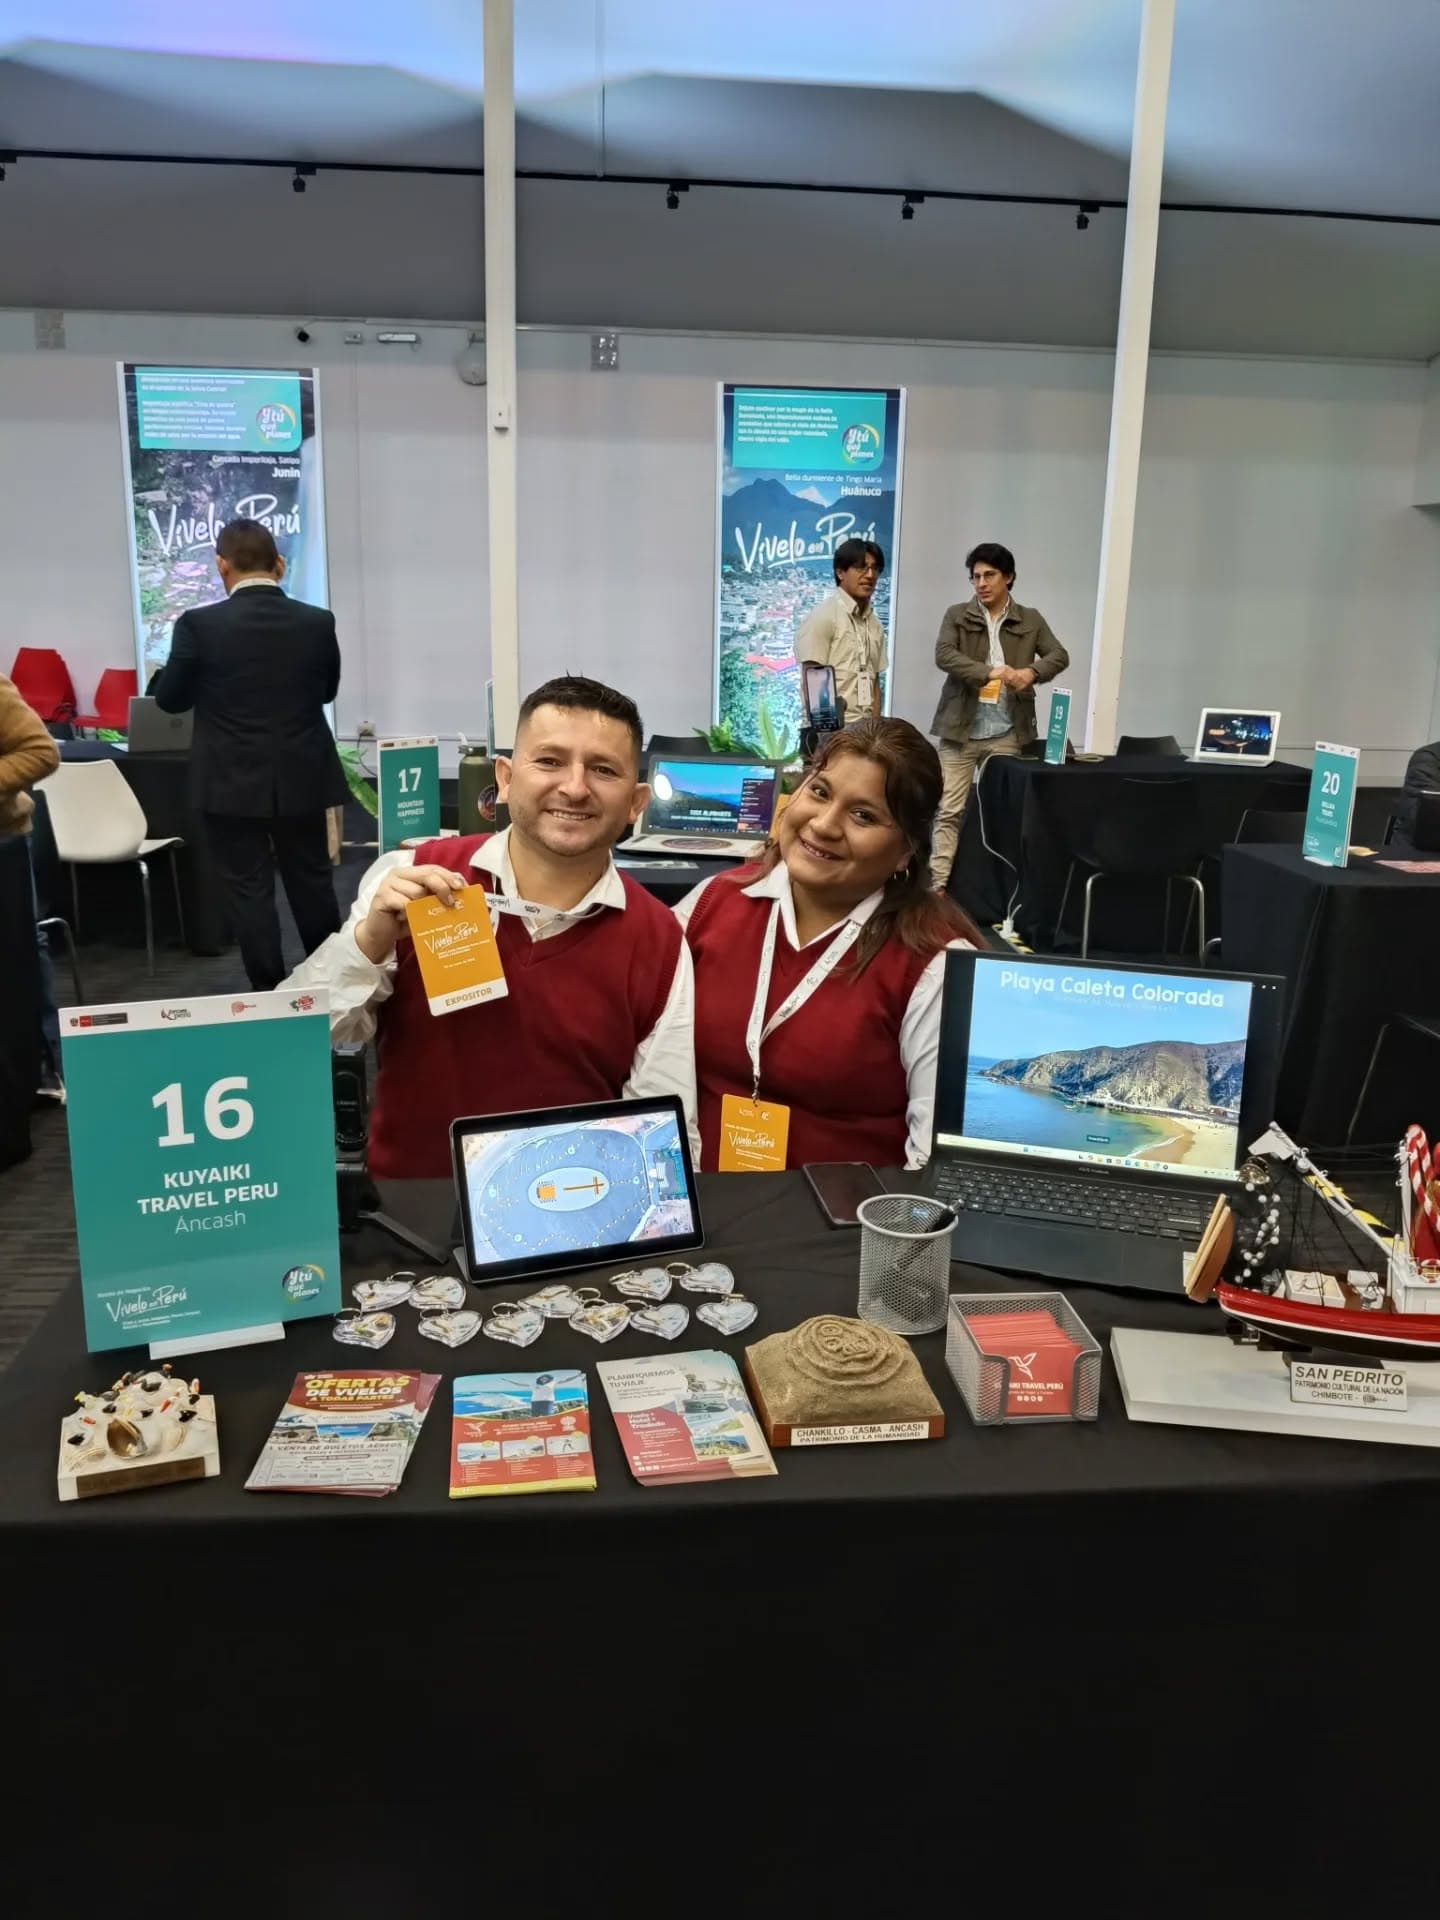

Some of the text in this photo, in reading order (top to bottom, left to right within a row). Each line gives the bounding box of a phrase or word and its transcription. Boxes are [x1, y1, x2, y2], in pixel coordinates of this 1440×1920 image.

[836, 474, 844, 482] de
[841, 486, 882, 496] Huánuco
[398, 767, 422, 793] 17
[1321, 770, 1340, 796] 20
[444, 987, 493, 1006] EXPOSITOR
[1000, 970, 1055, 994] Playa
[1061, 976, 1125, 998] Caleta
[1132, 983, 1225, 1008] Colorada
[152, 1076, 254, 1147] 16
[164, 1163, 251, 1189] KUYAIKI
[137, 1182, 279, 1215] TRAVEL PERU
[175, 1210, 246, 1235] Áncash
[152, 1285, 187, 1305] Perú
[305, 1375, 411, 1389] OFERTAS
[1295, 1366, 1404, 1386] SAN PEDRITO
[306, 1387, 402, 1397] DE VUELOS
[1295, 1380, 1331, 1390] PATRIMONIO
[1332, 1383, 1361, 1393] CULTURAL
[1363, 1385, 1371, 1393] DE
[1311, 1390, 1353, 1401] CHIMBOTE
[797, 1427, 845, 1438] CHANKILLO
[852, 1425, 882, 1435] CASMA
[889, 1423, 924, 1432] ANCASH
[800, 1434, 848, 1443] PATRIMONIO
